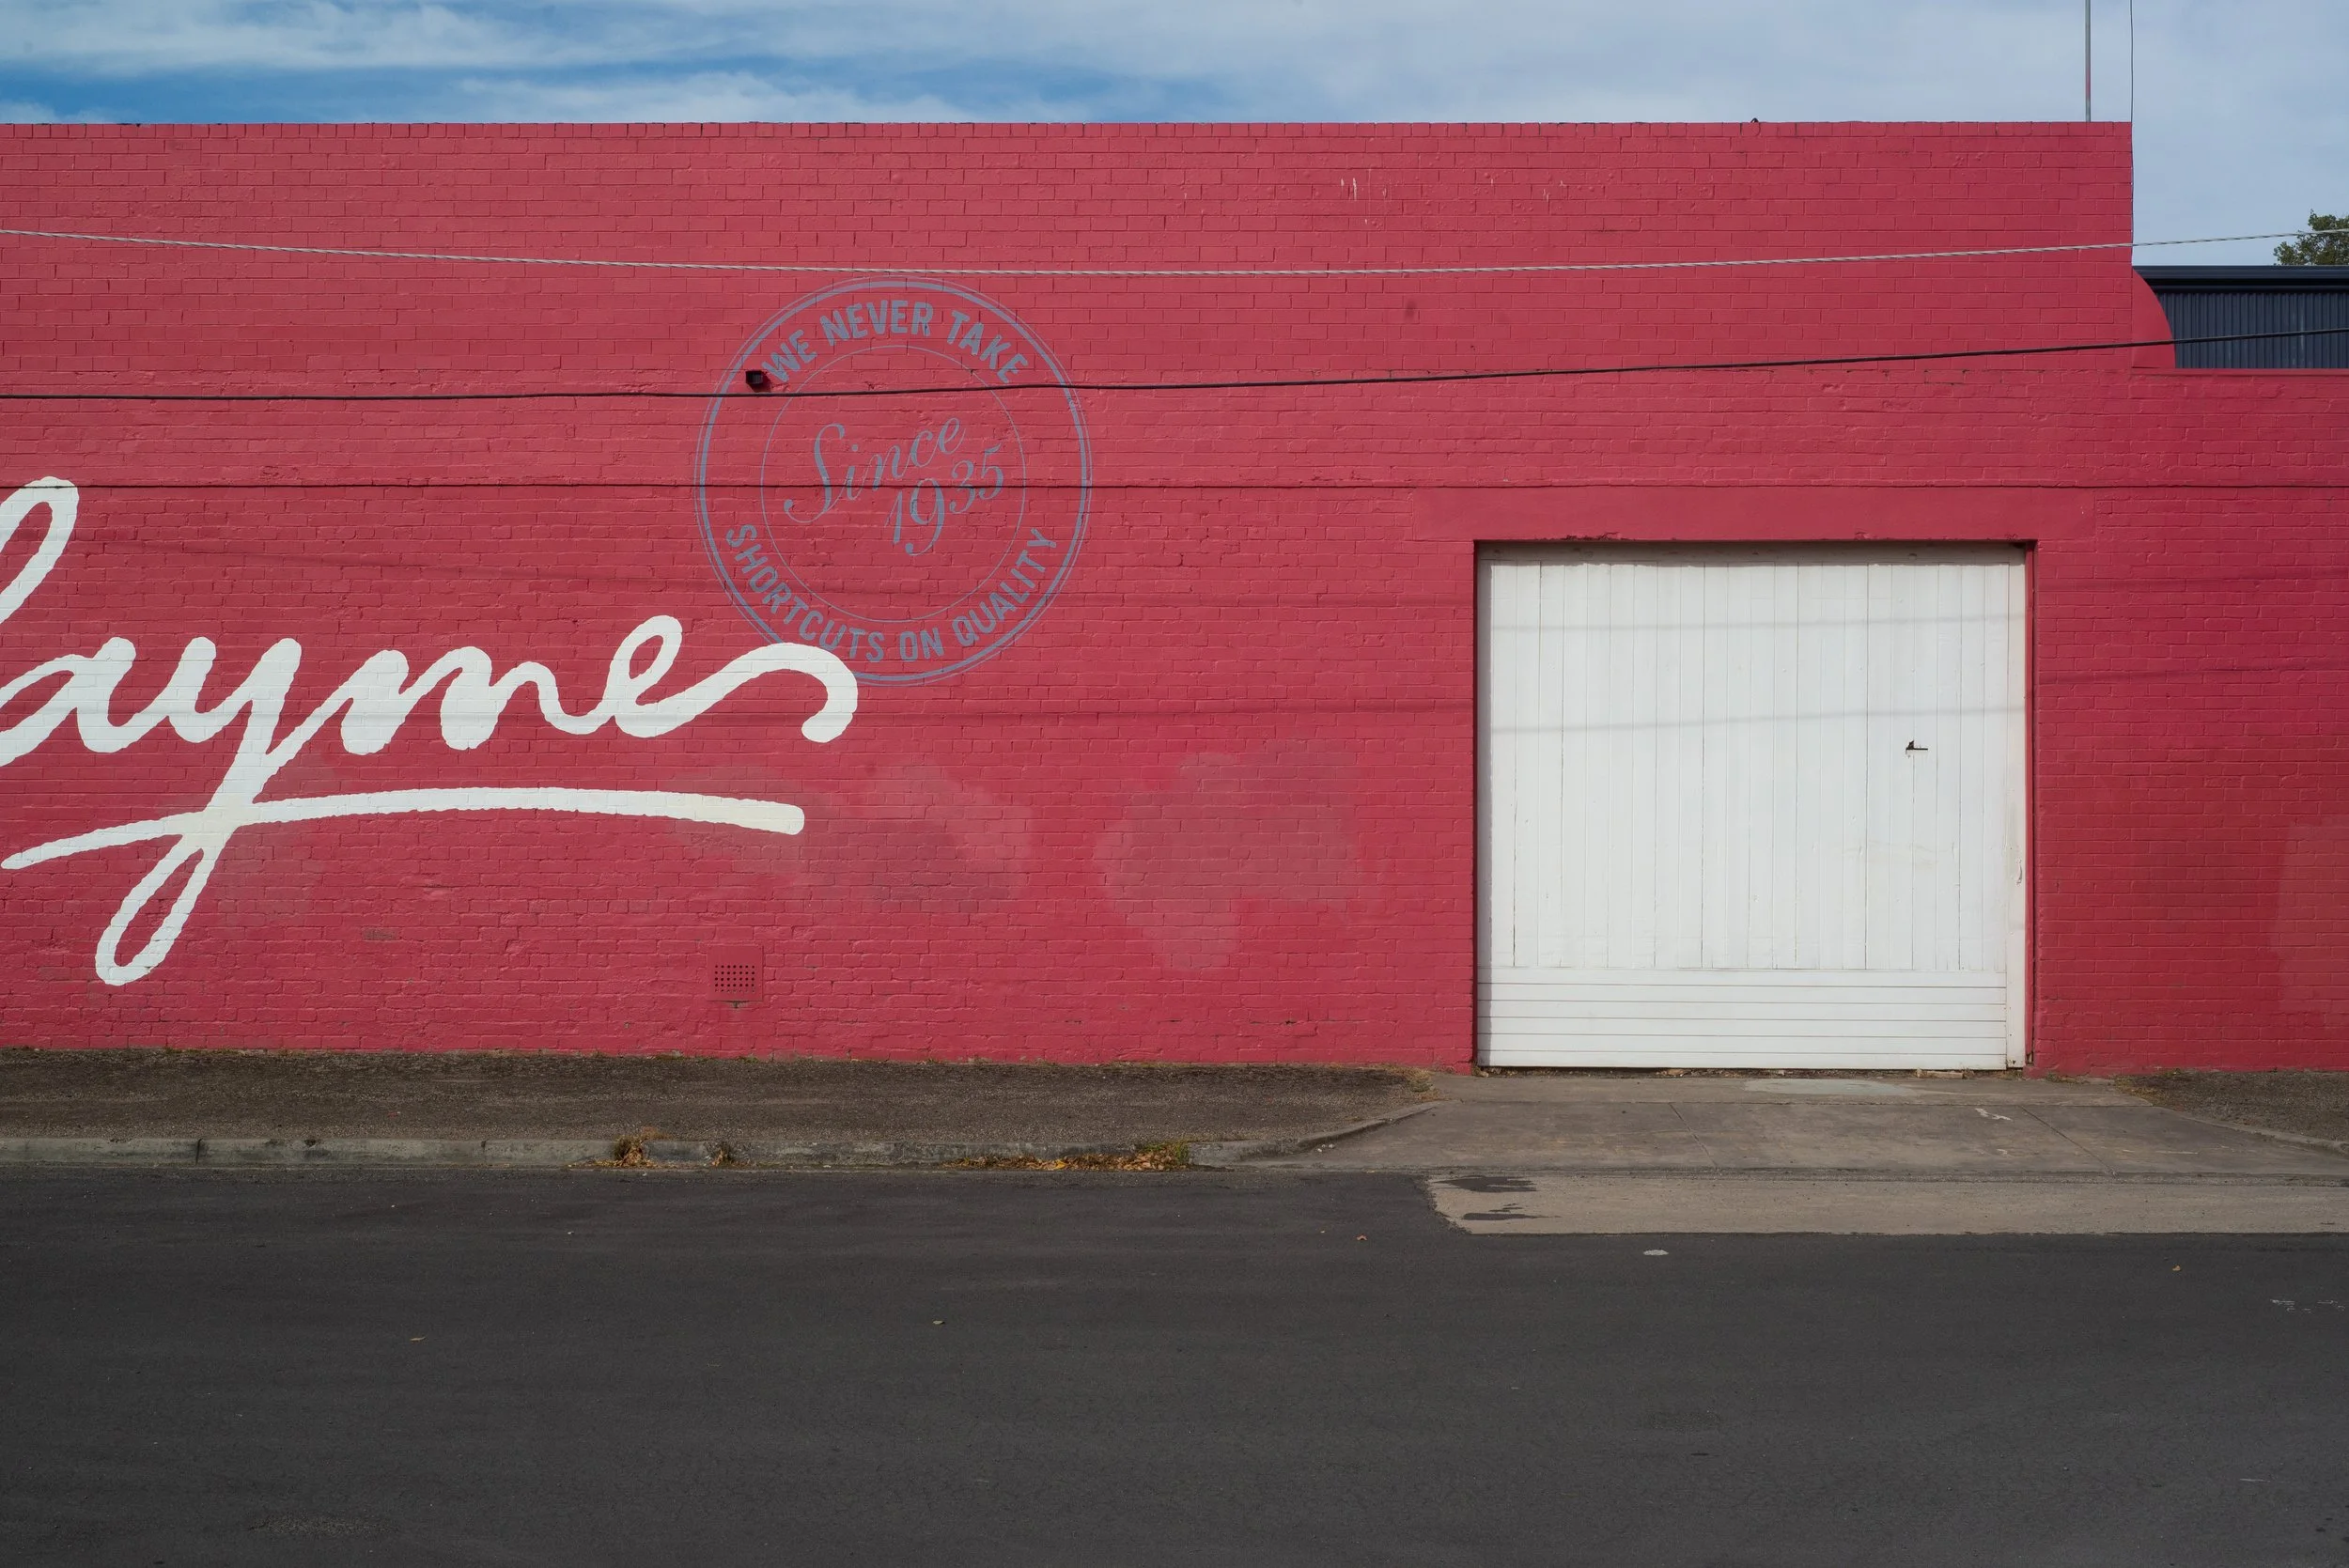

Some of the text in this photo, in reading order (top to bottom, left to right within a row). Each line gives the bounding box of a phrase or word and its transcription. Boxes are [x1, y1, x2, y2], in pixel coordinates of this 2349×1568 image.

[762, 299, 1029, 384] WE NEVER TAKE
[783, 417, 967, 523] Since
[884, 442, 1004, 556] 1935
[725, 523, 1057, 663] SHORTCUTS ON QUALITY
[0, 475, 859, 986] aymes
